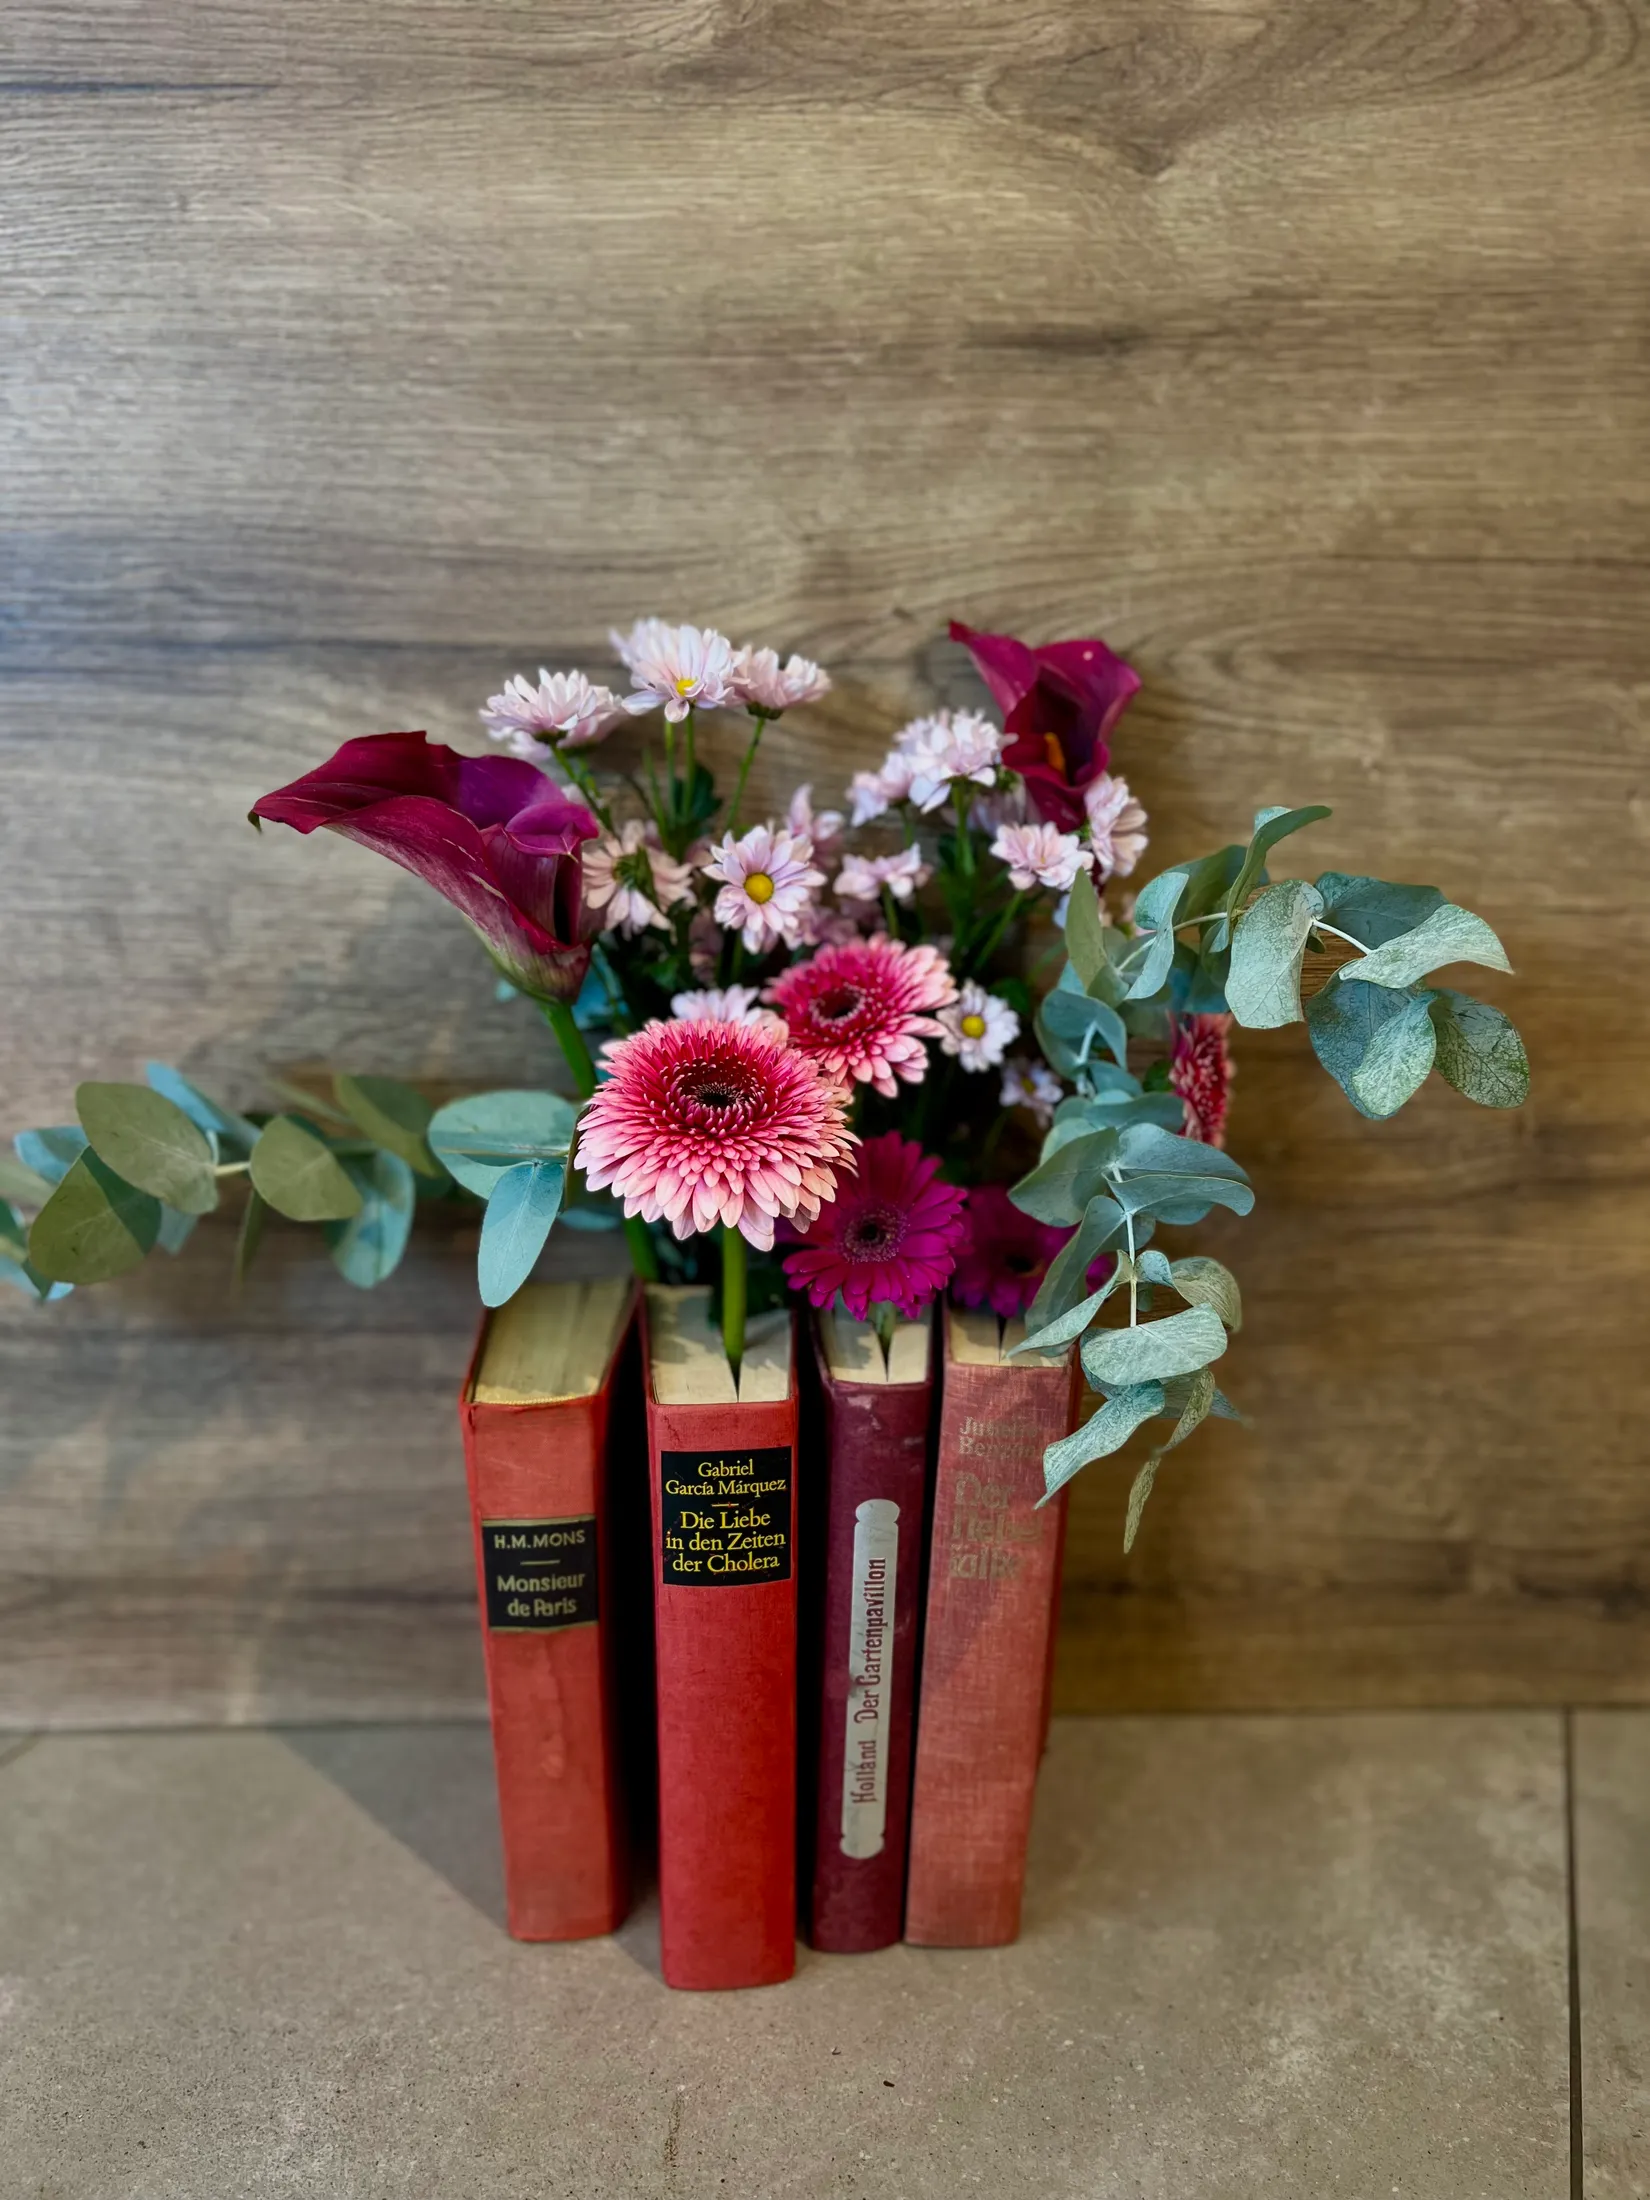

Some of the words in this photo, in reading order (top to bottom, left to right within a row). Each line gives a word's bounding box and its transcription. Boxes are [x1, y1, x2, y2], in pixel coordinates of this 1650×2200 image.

[698, 1458, 754, 1477] Gabriel
[665, 1479, 715, 1496] García
[718, 1478, 787, 1498] Márquez
[680, 1511, 715, 1529] Die
[720, 1507, 771, 1529] Liebe
[665, 1530, 684, 1550] in
[688, 1531, 723, 1551] den
[727, 1530, 786, 1551] Zeiten
[672, 1553, 702, 1572] der
[707, 1550, 780, 1573] Cholera
[497, 1574, 585, 1592] Monsieur
[507, 1598, 530, 1617] de
[533, 1597, 577, 1617] Paris
[855, 1556, 887, 1687] Gartenpavillon
[853, 1689, 880, 1724] Der
[851, 1739, 878, 1804] Holland
